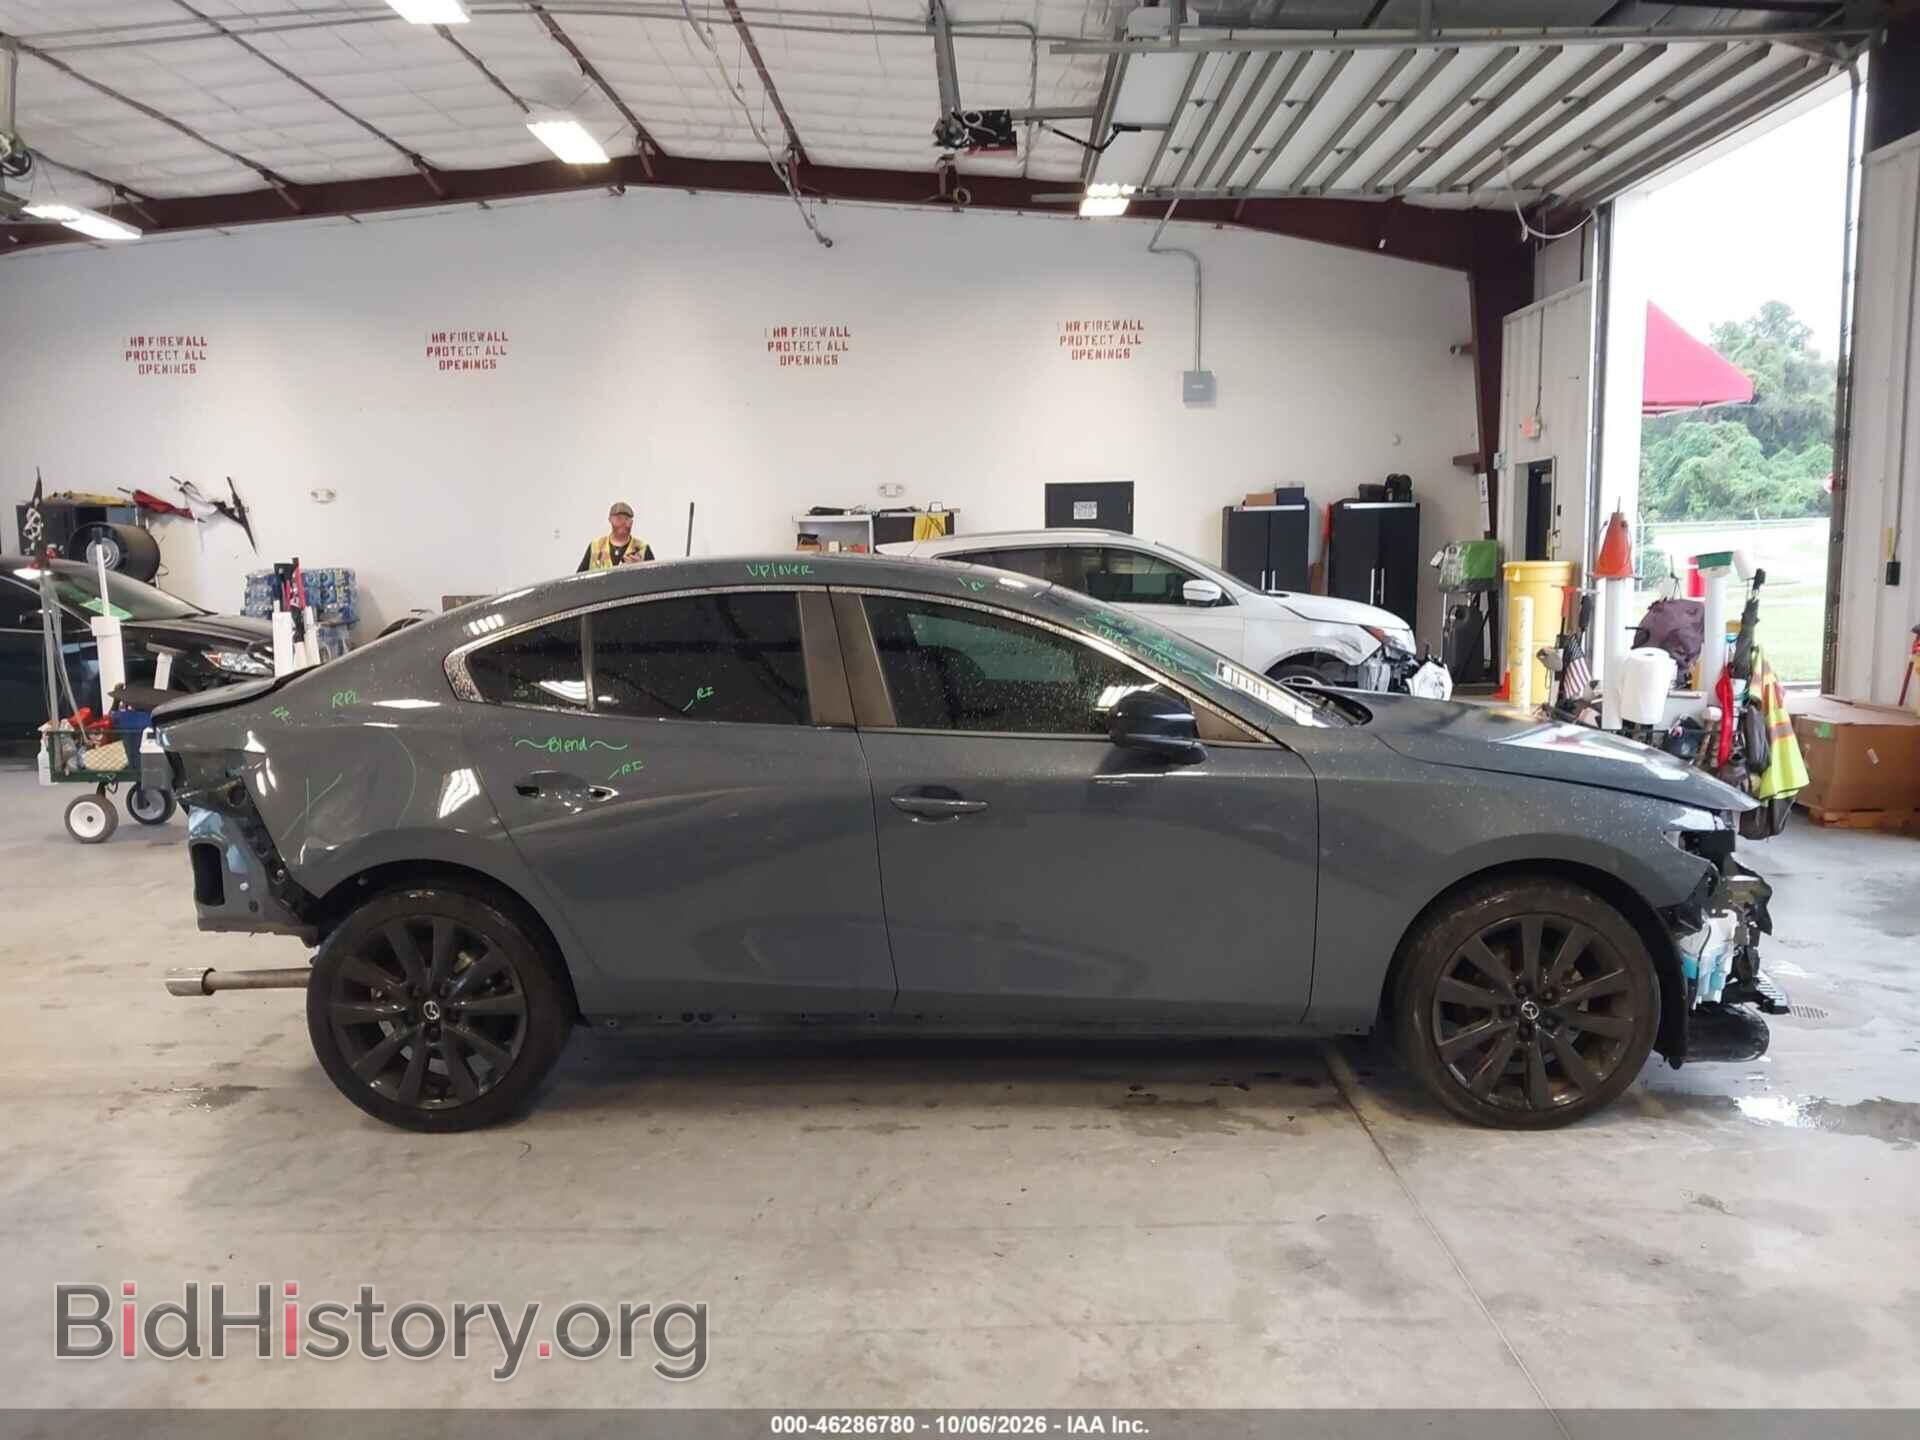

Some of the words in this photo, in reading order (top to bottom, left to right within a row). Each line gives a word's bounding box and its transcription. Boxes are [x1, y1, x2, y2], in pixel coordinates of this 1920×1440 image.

[773, 327, 788, 337] HR
[791, 326, 851, 337] FIREWALL
[1065, 320, 1080, 332] HR
[1083, 319, 1144, 331] FIREWALL
[130, 336, 145, 347] HR
[148, 335, 208, 347] FIREWALL
[431, 332, 446, 343] HR
[449, 331, 509, 342] FIREWALL
[1060, 335, 1114, 346] PROTECT
[1119, 334, 1141, 344] ALL
[426, 346, 480, 357] PROTECT
[485, 345, 507, 356] ALL
[767, 341, 821, 352] PROTECT
[826, 340, 849, 351] ALL
[125, 350, 179, 361] PROTECT
[184, 350, 206, 360] ALL
[780, 354, 838, 366] OPENINGS
[1071, 348, 1130, 360] OPENINGS
[138, 363, 197, 375] OPENINGS
[439, 359, 497, 370] OPENINGS
[548, 736, 588, 753] Blend
